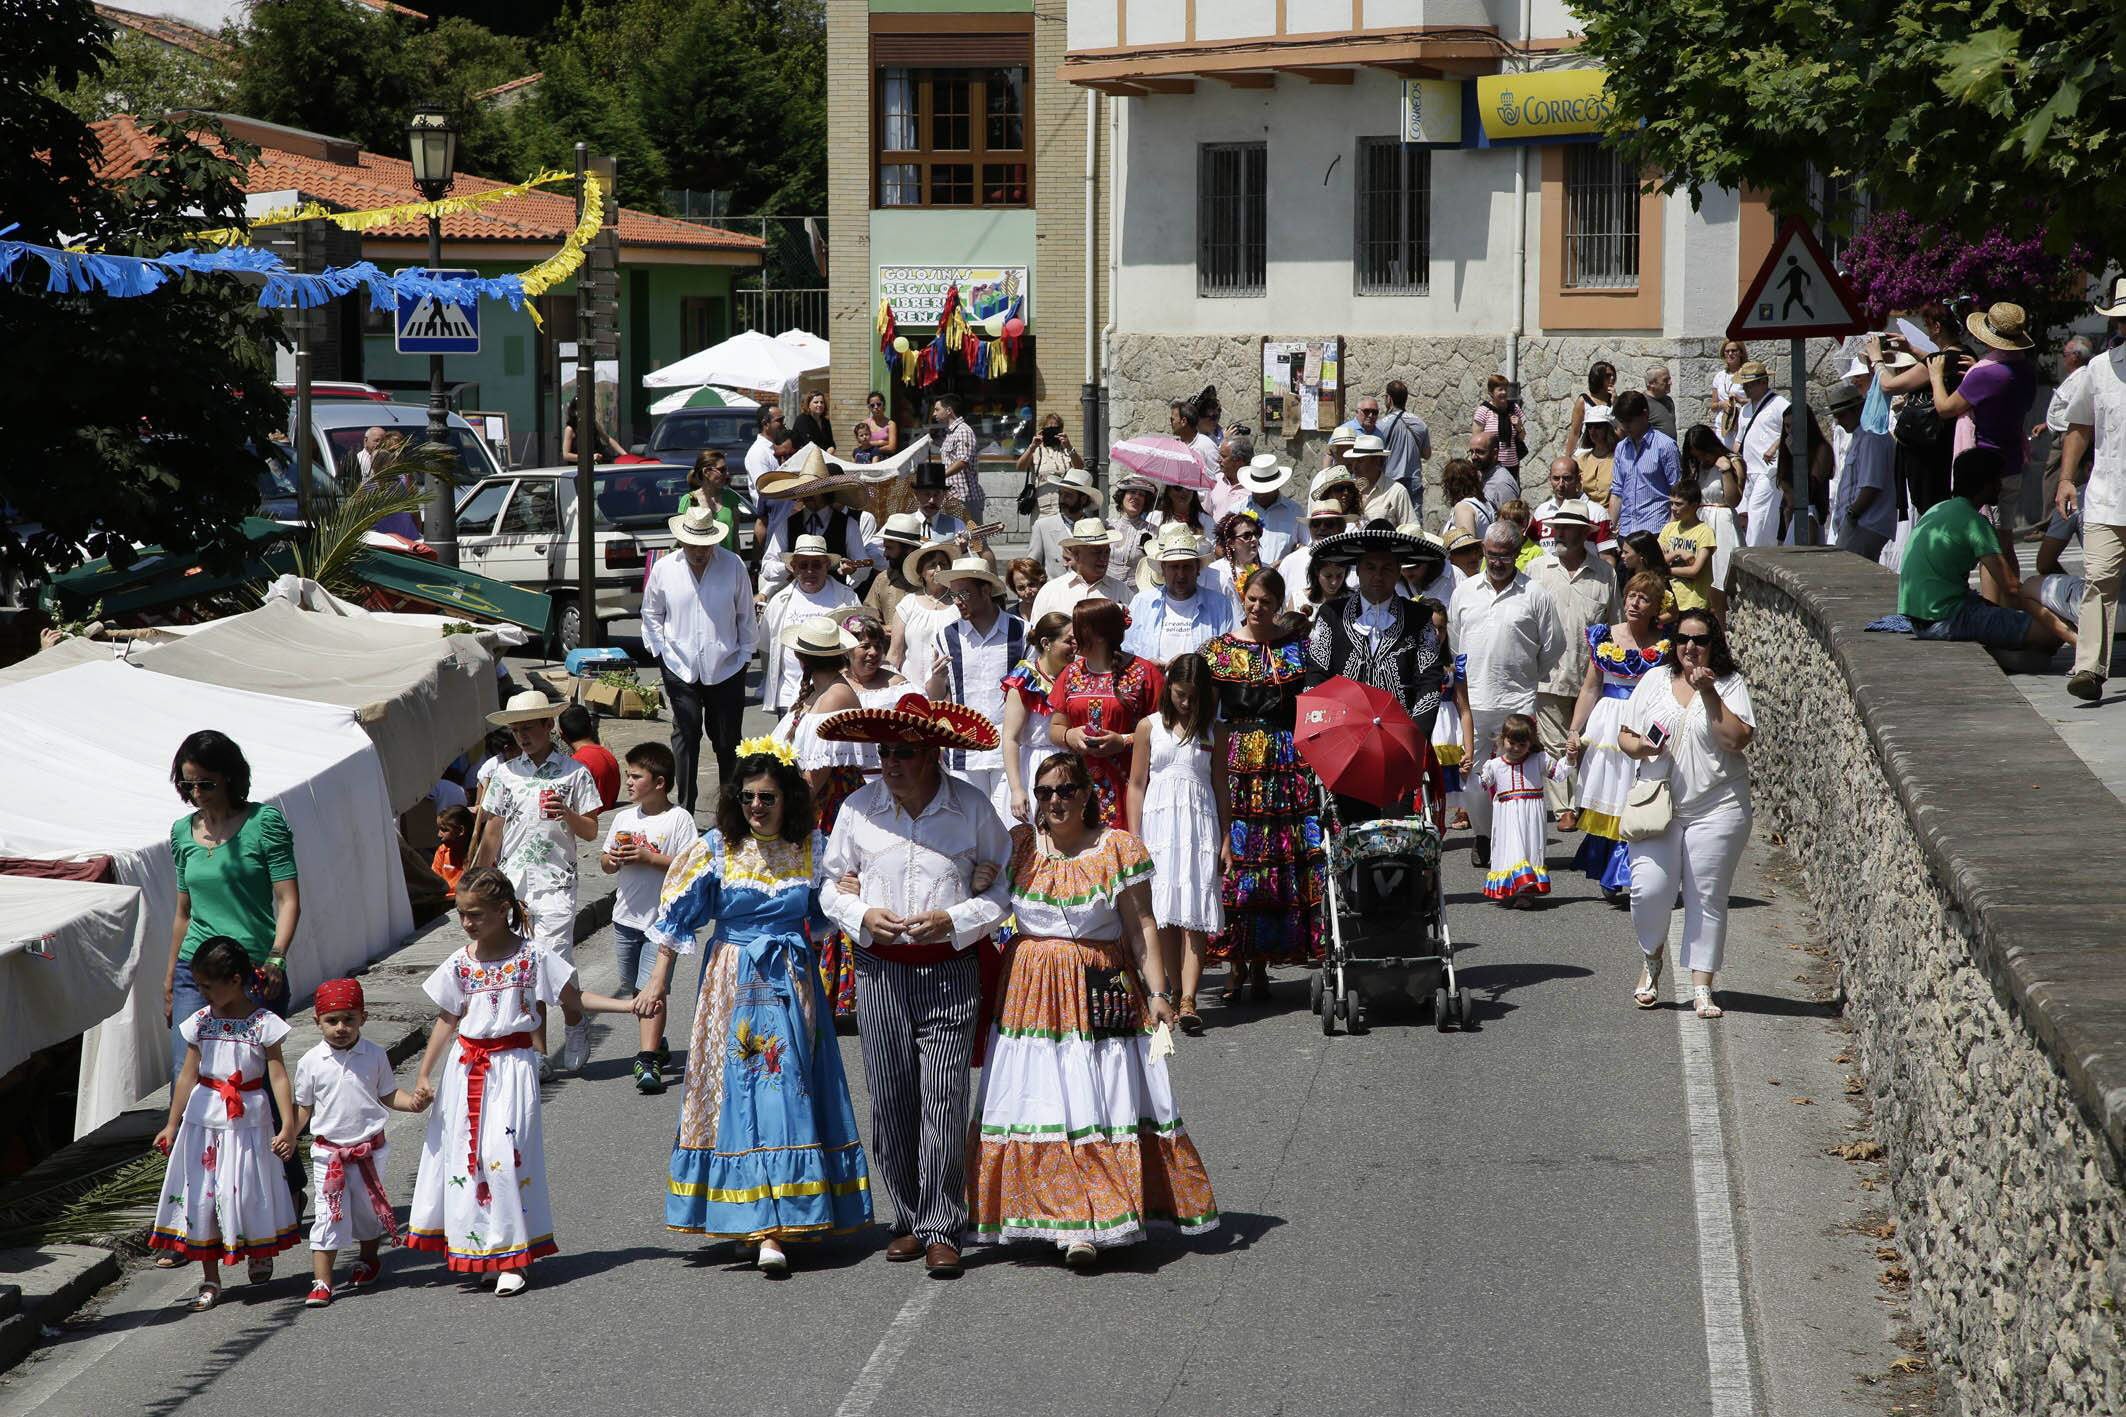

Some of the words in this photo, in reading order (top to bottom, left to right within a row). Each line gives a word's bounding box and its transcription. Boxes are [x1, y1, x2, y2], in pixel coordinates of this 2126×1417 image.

[1409, 82, 1422, 140] CORREOS
[1523, 95, 1610, 125] CORREOS
[885, 269, 972, 280] GOLOSINAS
[888, 297, 947, 308] LIBRERI
[892, 311, 940, 322] RENS
[1670, 537, 1697, 553] SPRING
